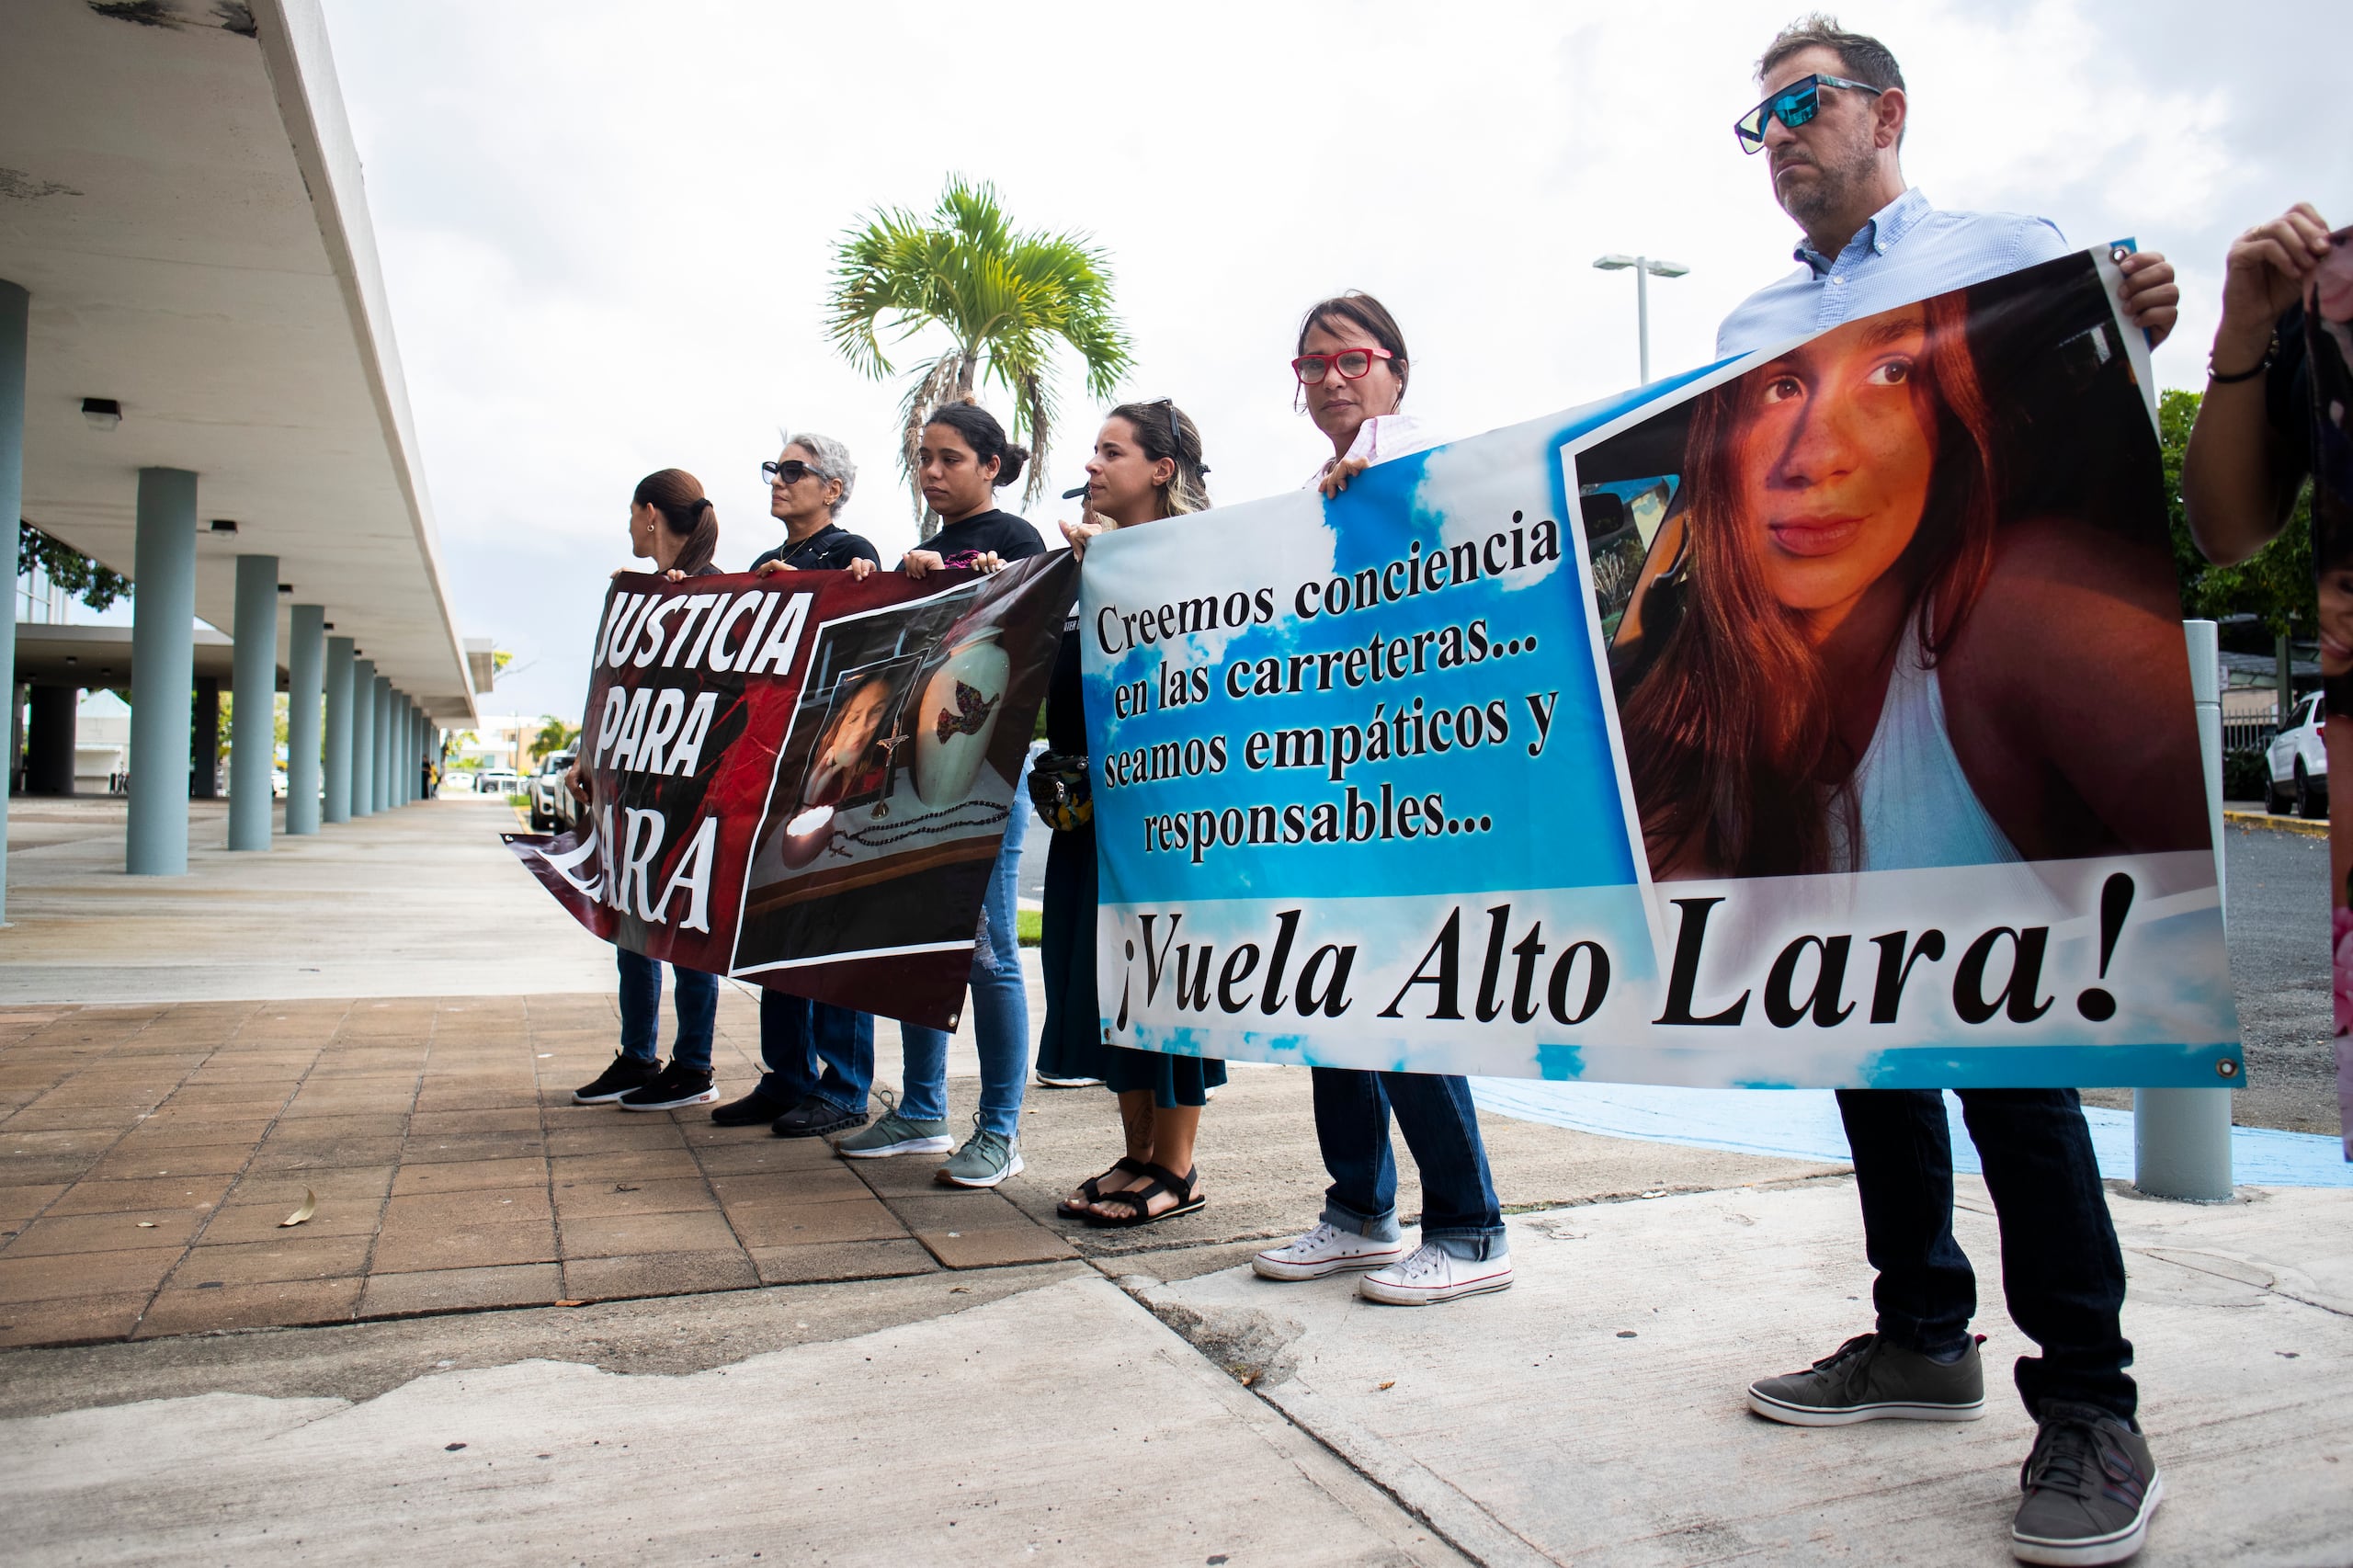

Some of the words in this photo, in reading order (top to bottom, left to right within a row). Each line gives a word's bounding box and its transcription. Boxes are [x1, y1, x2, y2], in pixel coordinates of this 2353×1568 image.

[1097, 585, 1275, 655] Creemos
[1294, 510, 1562, 619] conciencia
[595, 590, 814, 676] JUSTICIA
[1114, 676, 1148, 720] en
[1158, 660, 1210, 711] las
[1226, 618, 1538, 699] carreteras...
[593, 685, 720, 778] PARA
[1104, 734, 1227, 789] seamos
[1245, 697, 1509, 781] empáticos
[1527, 691, 1560, 756] y
[1144, 783, 1493, 863] responsables...
[1116, 909, 1358, 1032] ¡Vuela
[1376, 903, 1610, 1025] Alto
[1651, 872, 2134, 1028] Lara!
